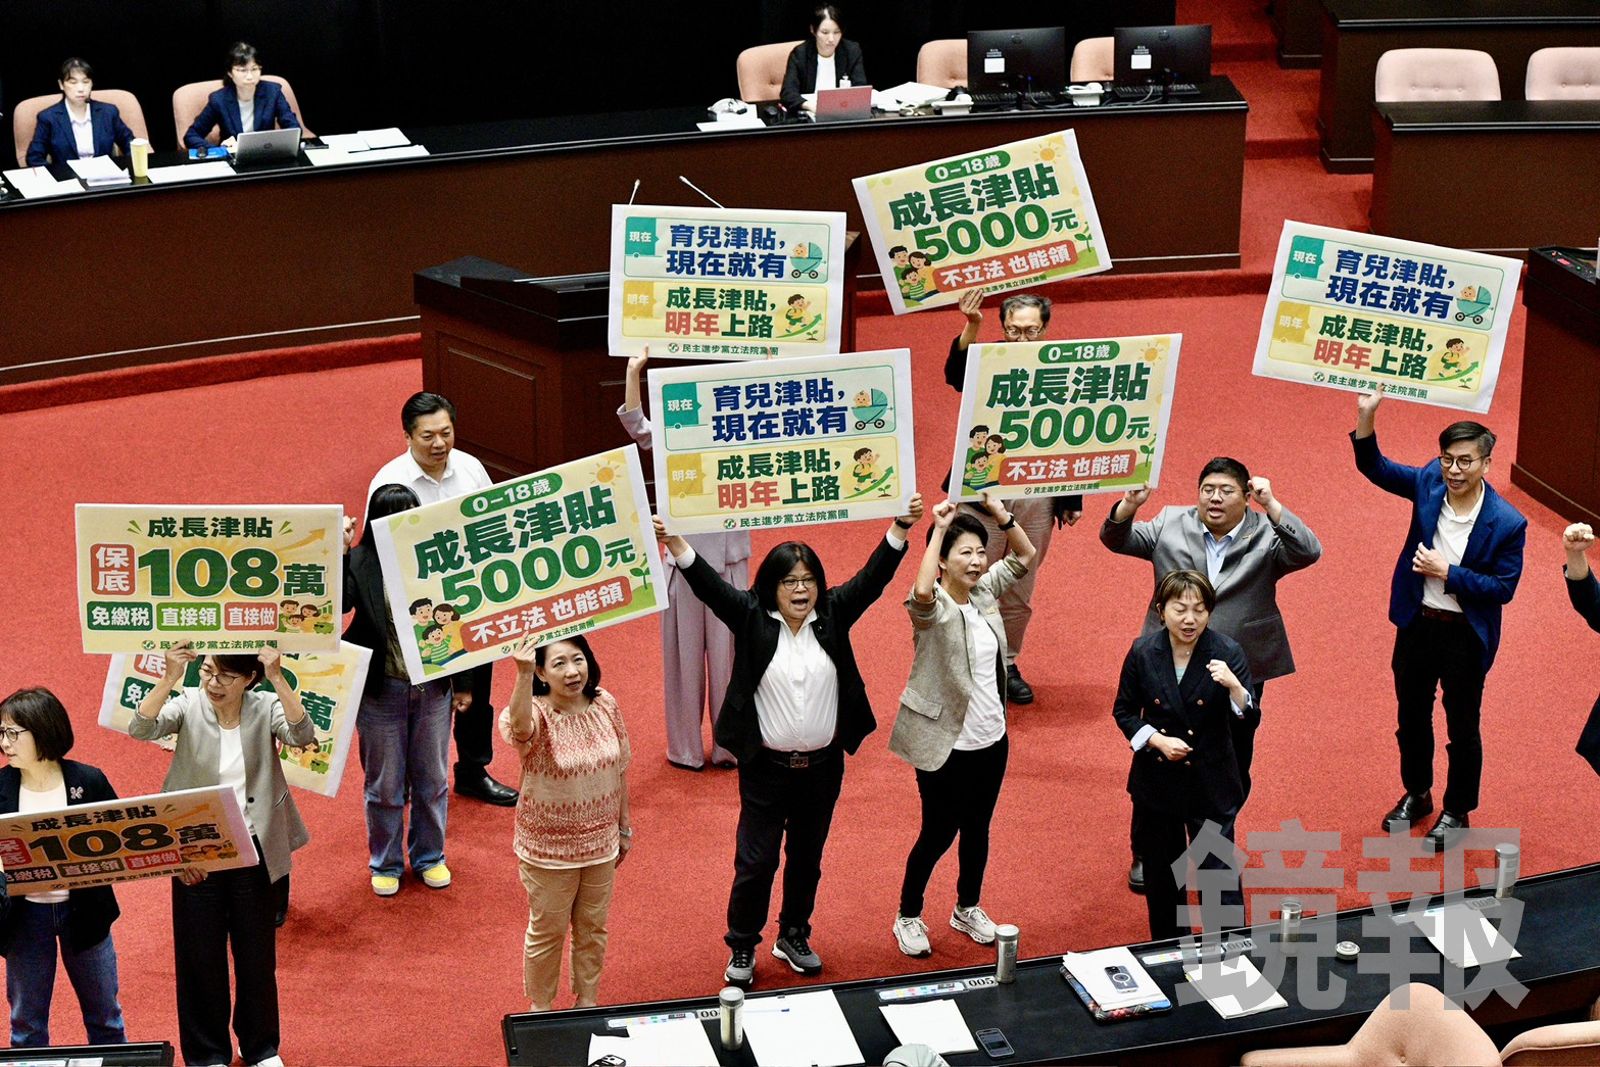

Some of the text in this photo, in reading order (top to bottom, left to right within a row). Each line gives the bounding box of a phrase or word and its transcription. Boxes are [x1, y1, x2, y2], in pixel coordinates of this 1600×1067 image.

[889, 162, 1060, 231] 成長津貼
[629, 231, 651, 243] 現在
[913, 203, 1078, 262] 5000元
[666, 250, 787, 279] 現在就有
[940, 242, 1071, 289] 不立法 也能領
[1292, 250, 1317, 265] 現在
[627, 293, 649, 306] 明年
[1325, 275, 1453, 320] 現在就有
[665, 312, 773, 338] 明年上路
[1279, 315, 1303, 329] 明年
[1313, 339, 1429, 380] 明年上路
[986, 362, 1151, 409] 成長津貼
[667, 398, 693, 411] 現在
[712, 406, 848, 442] 現在就有
[1001, 404, 1150, 450] 5000元
[671, 469, 697, 481] 明年
[1006, 453, 1129, 481] 不立法 也能領
[717, 475, 840, 509] 明年上路
[147, 516, 273, 538] 成長津貼
[413, 484, 618, 580] 成長津貼
[740, 508, 848, 528] 民主進步黨立法院黨團
[96, 546, 130, 592] 保底
[138, 547, 326, 597] 108萬
[441, 534, 636, 614] 5000元
[160, 607, 217, 627] 直接領
[228, 607, 275, 626] 直接做
[469, 581, 625, 645] 不立法 也能領
[31, 805, 157, 832] 成長津貼
[29, 823, 221, 862] 108萬
[64, 859, 121, 876] 直接領
[130, 851, 177, 867] 直接做
[968, 976, 994, 987] 005
[700, 1010, 721, 1018] 00
